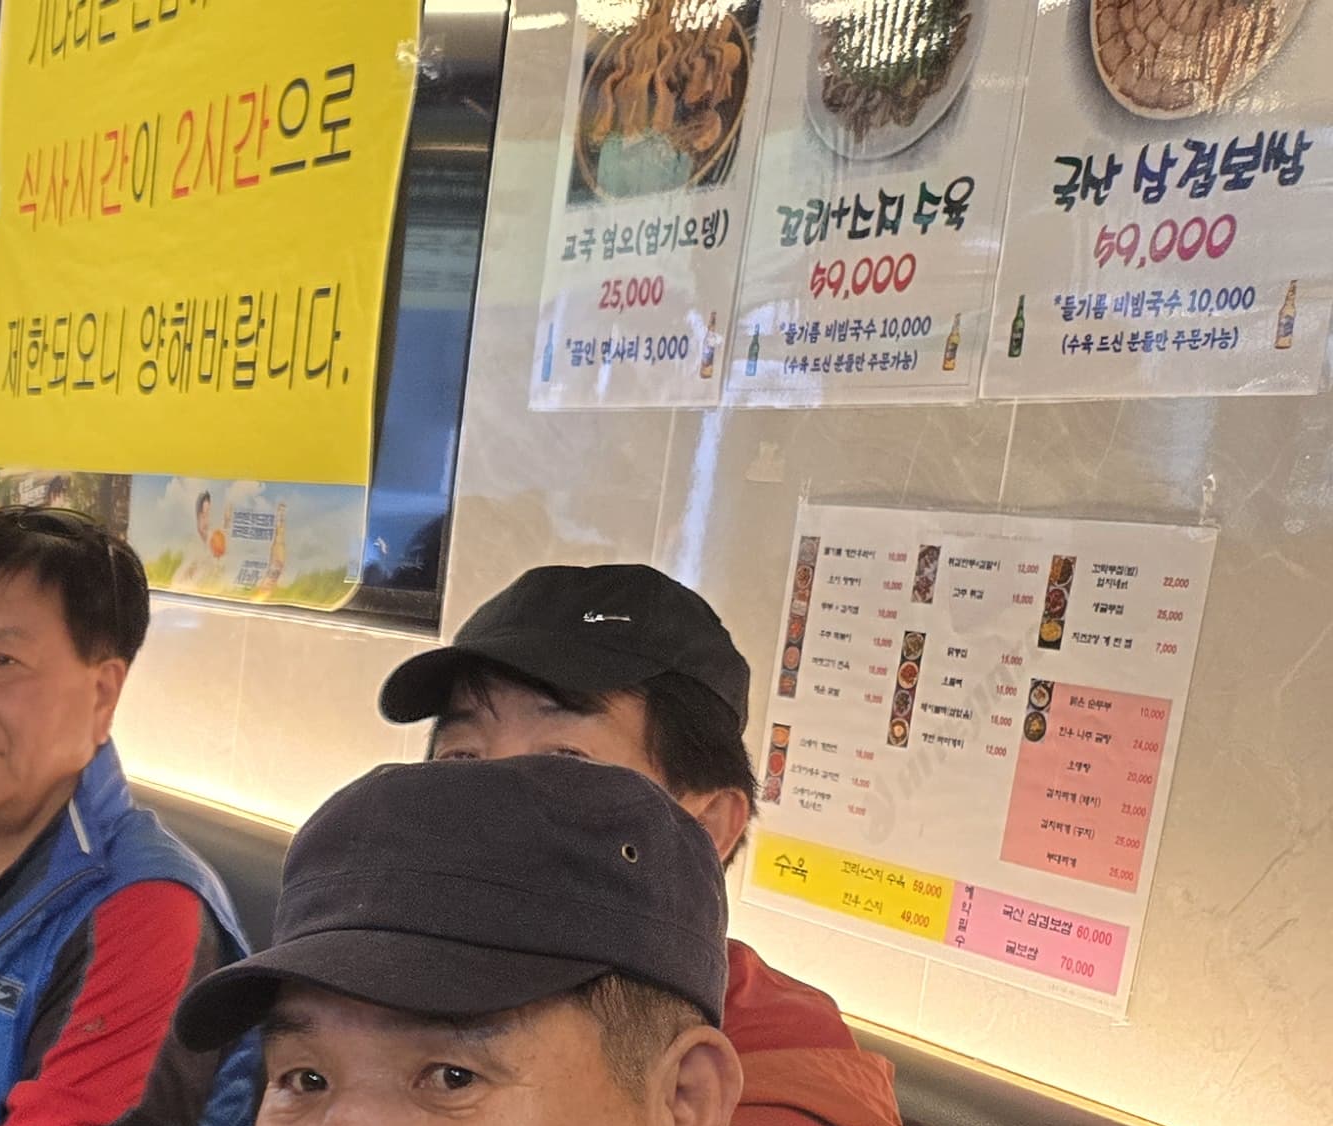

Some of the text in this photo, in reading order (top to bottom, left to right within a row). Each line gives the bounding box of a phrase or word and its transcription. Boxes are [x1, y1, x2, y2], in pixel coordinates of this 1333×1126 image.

[17, 62, 356, 233] 식사시간이 2시간으로
[1052, 129, 1314, 212] 국산 삼겹보쌈
[776, 175, 976, 247] 꼬리+스지 수육
[1093, 213, 1238, 269] 59,000
[598, 275, 664, 314] 25,000
[809, 252, 917, 300] 59,000
[1113, 290, 1182, 320] 비빔국수
[1186, 285, 1256, 316] 10,000
[1, 282, 350, 398] 제한되오니 양해바랍니다.
[824, 317, 877, 343] 비빔국수
[879, 315, 932, 342] 10,000
[1095, 334, 1123, 353] 드신
[1127, 332, 1170, 353] 분들만
[643, 334, 689, 366] 3,000
[810, 353, 831, 373] 드신
[833, 352, 865, 374] 분들만
[773, 853, 809, 883] 수육
[911, 878, 943, 899] 59,000
[899, 909, 931, 929] 49,000
[1002, 903, 1025, 923] 국산
[1075, 924, 1113, 947] 60,000
[1059, 955, 1095, 978] 70,000
